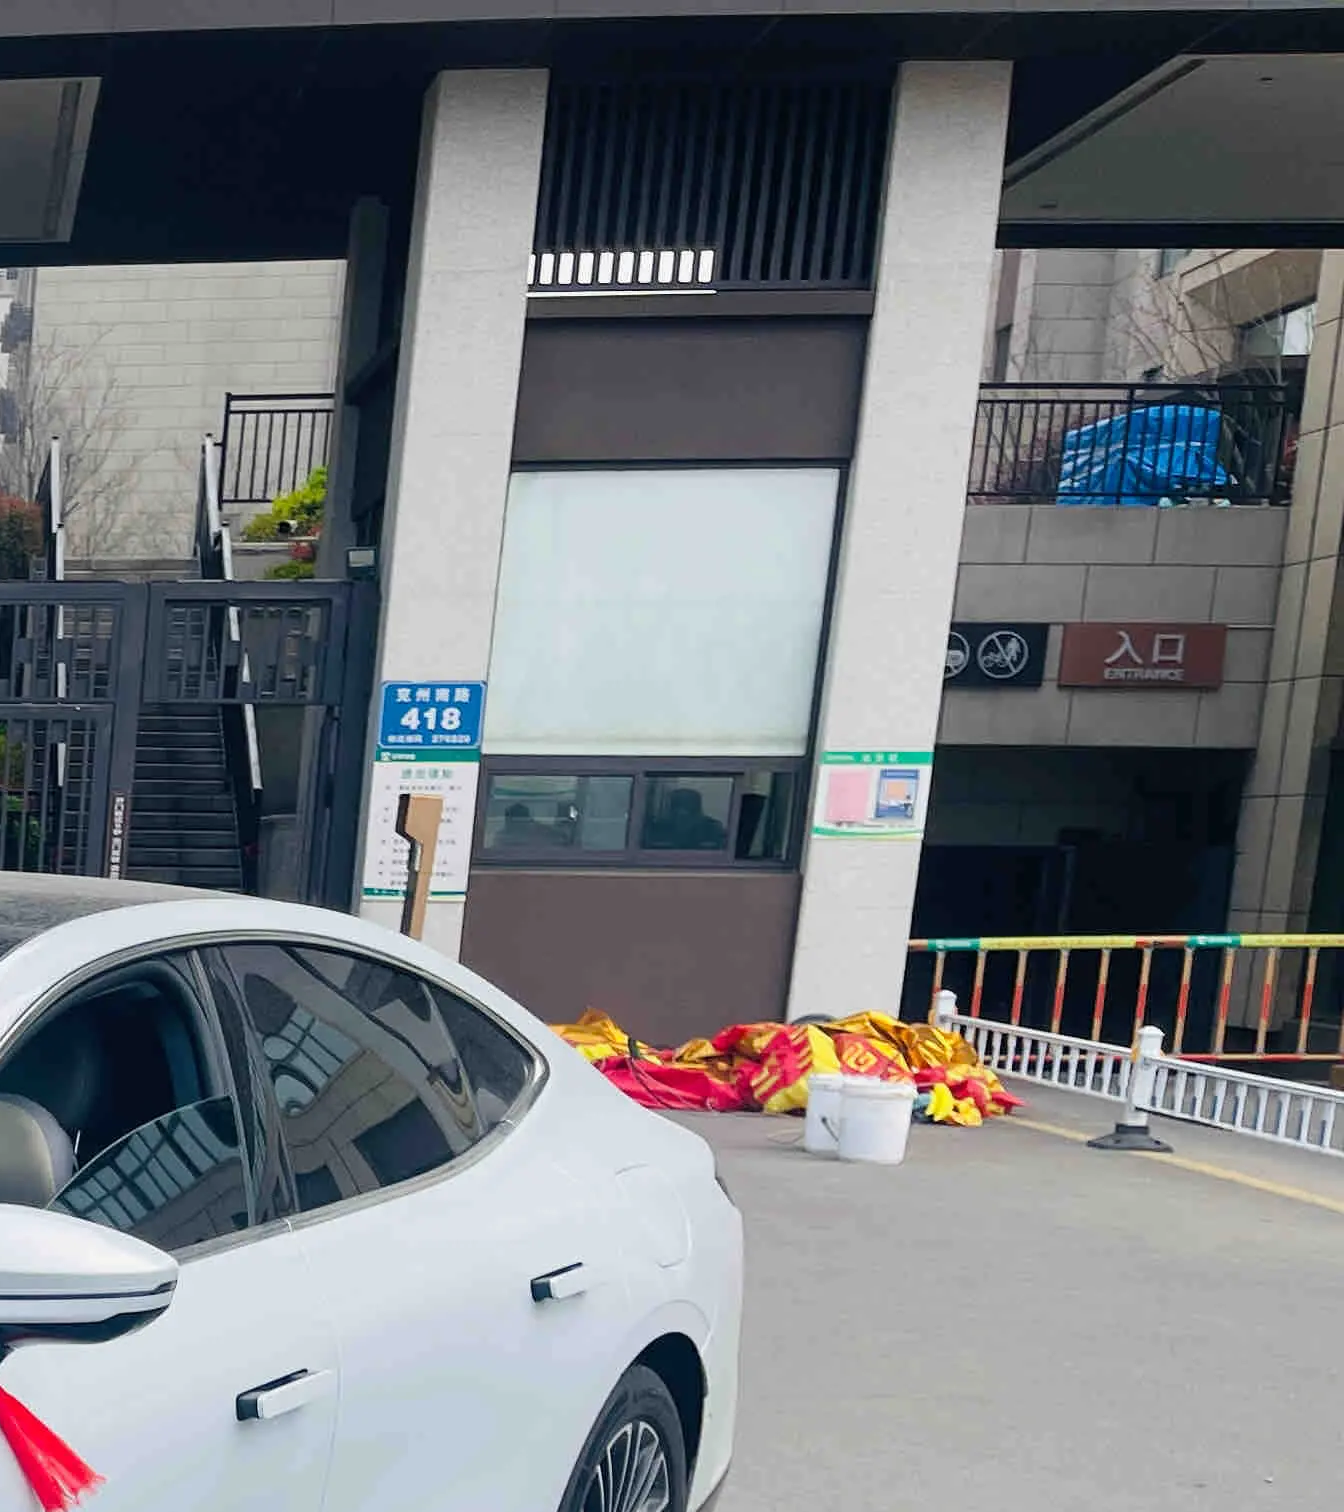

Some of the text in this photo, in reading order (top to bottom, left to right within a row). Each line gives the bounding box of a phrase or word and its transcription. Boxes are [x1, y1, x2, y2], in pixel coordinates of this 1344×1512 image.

[1103, 630, 1184, 664] 入口
[1103, 667, 1185, 681] ENTRANCE
[399, 706, 462, 731] 418
